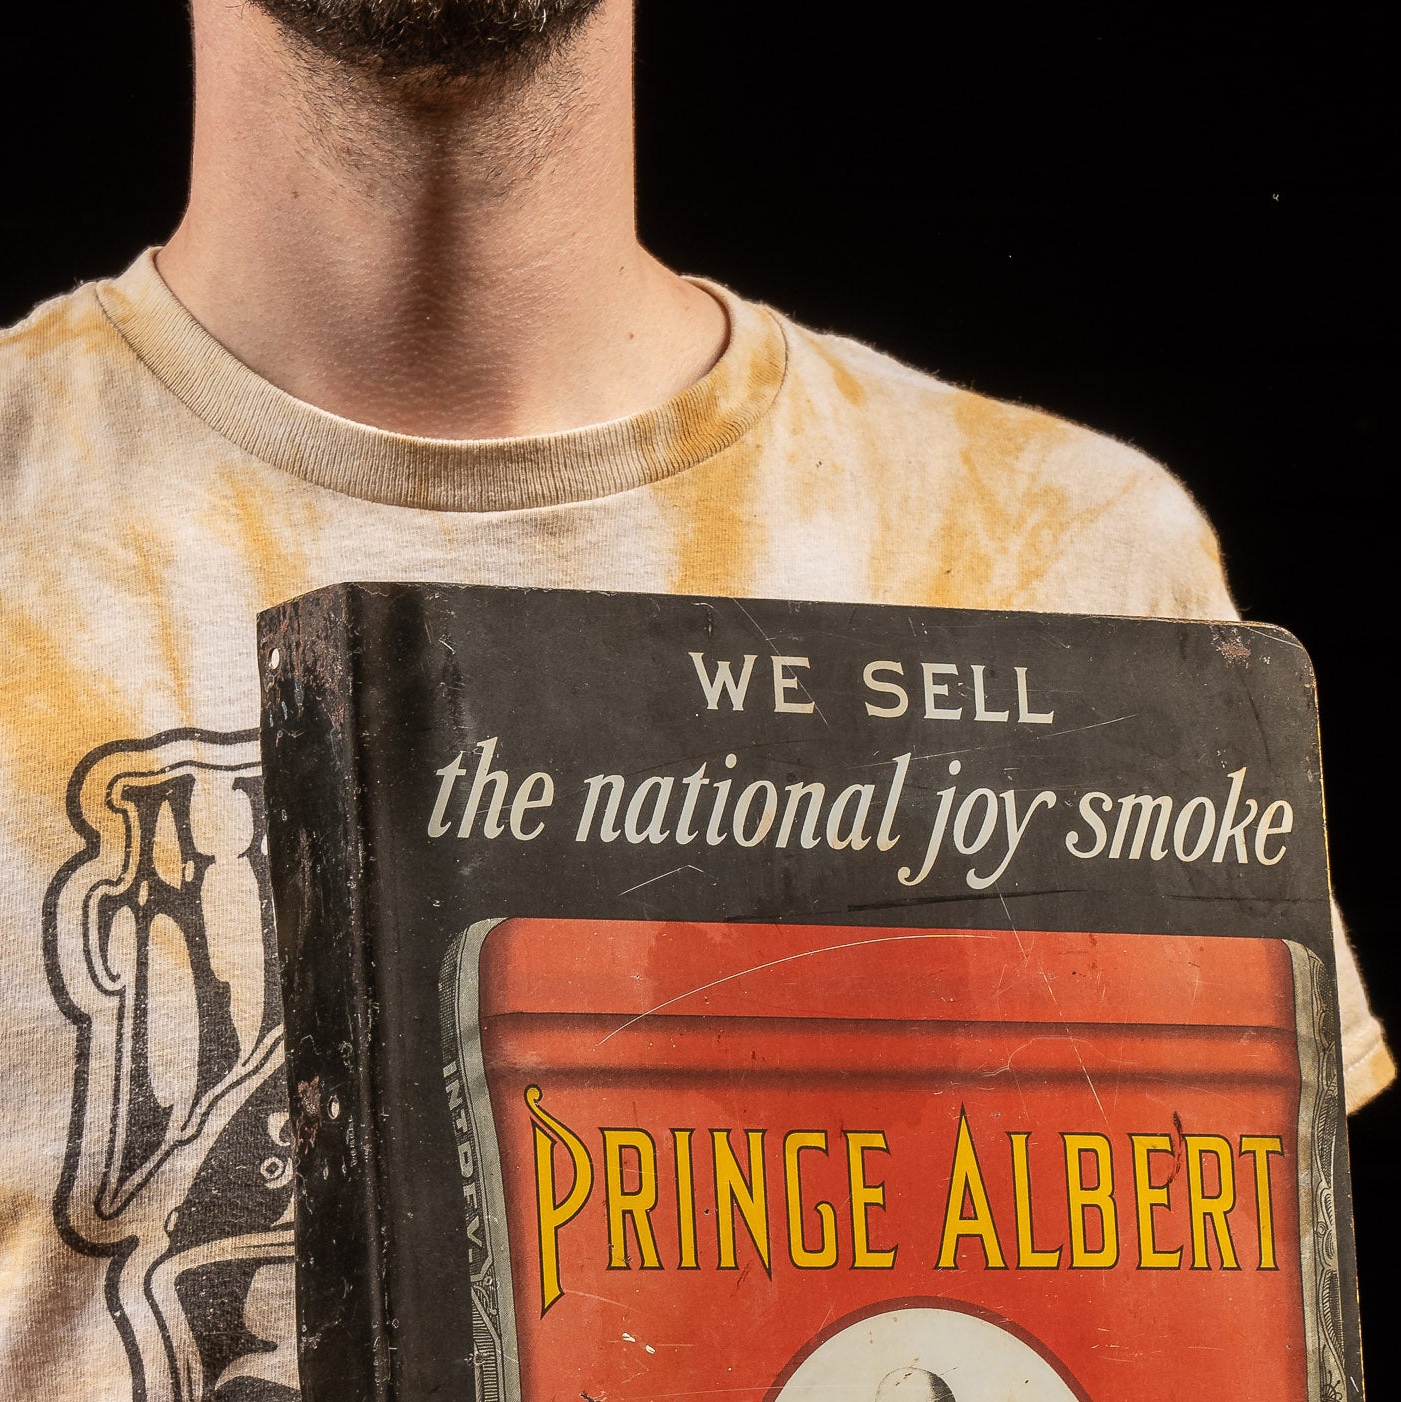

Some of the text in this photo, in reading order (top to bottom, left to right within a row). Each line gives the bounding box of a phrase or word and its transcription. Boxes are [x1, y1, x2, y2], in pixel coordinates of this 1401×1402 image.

[687, 651, 1055, 724] WE SELL
[426, 736, 1294, 890] the national joy smoke
[933, 1102, 1285, 1272] ALBERT
